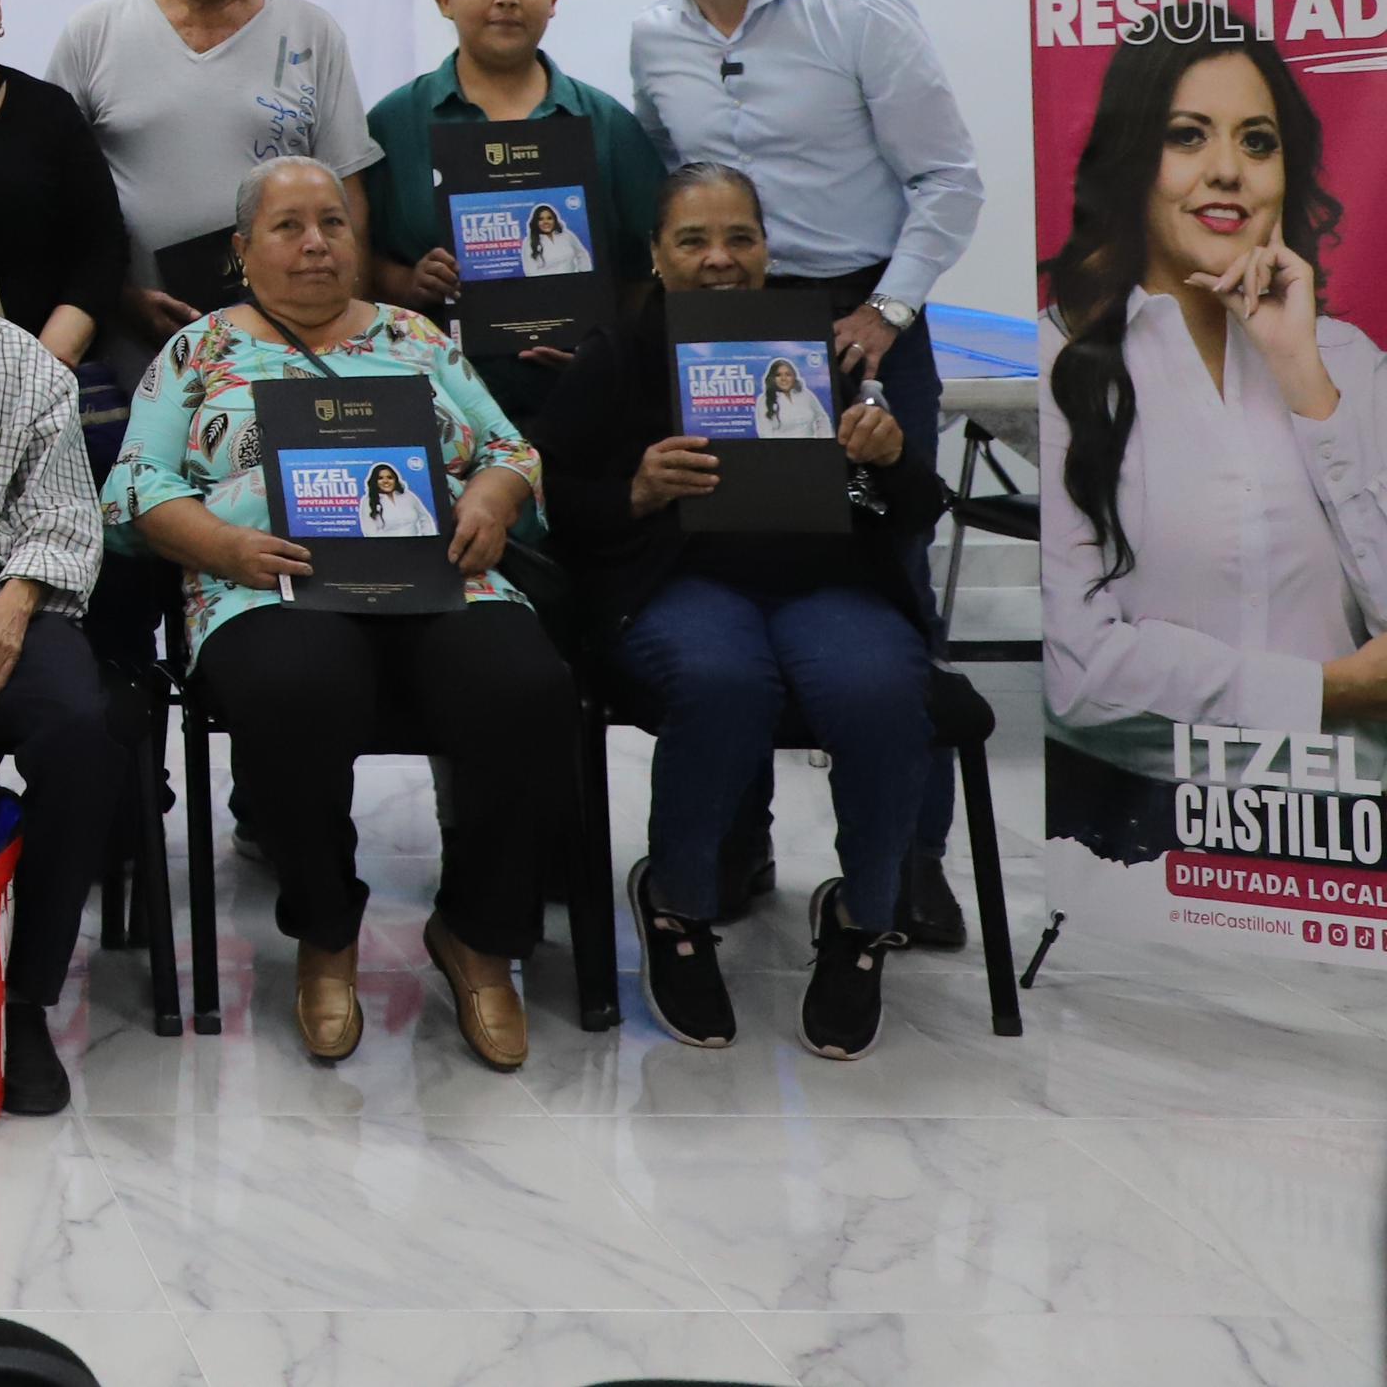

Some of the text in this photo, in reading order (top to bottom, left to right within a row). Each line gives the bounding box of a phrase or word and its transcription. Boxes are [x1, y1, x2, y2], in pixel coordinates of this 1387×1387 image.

[254, 96, 298, 159] Surf
[460, 211, 519, 229] ITZEL
[462, 225, 521, 243] CASTILLO
[689, 365, 753, 380] ITZEL
[689, 381, 755, 397] CASTILLO
[291, 469, 357, 483] ITZEL
[294, 483, 358, 498] CASTILLO
[1173, 723, 1382, 796] ITZEL
[1175, 783, 1382, 865] CASTILLO
[1176, 864, 1387, 908] DIPUTADA LOCAL
